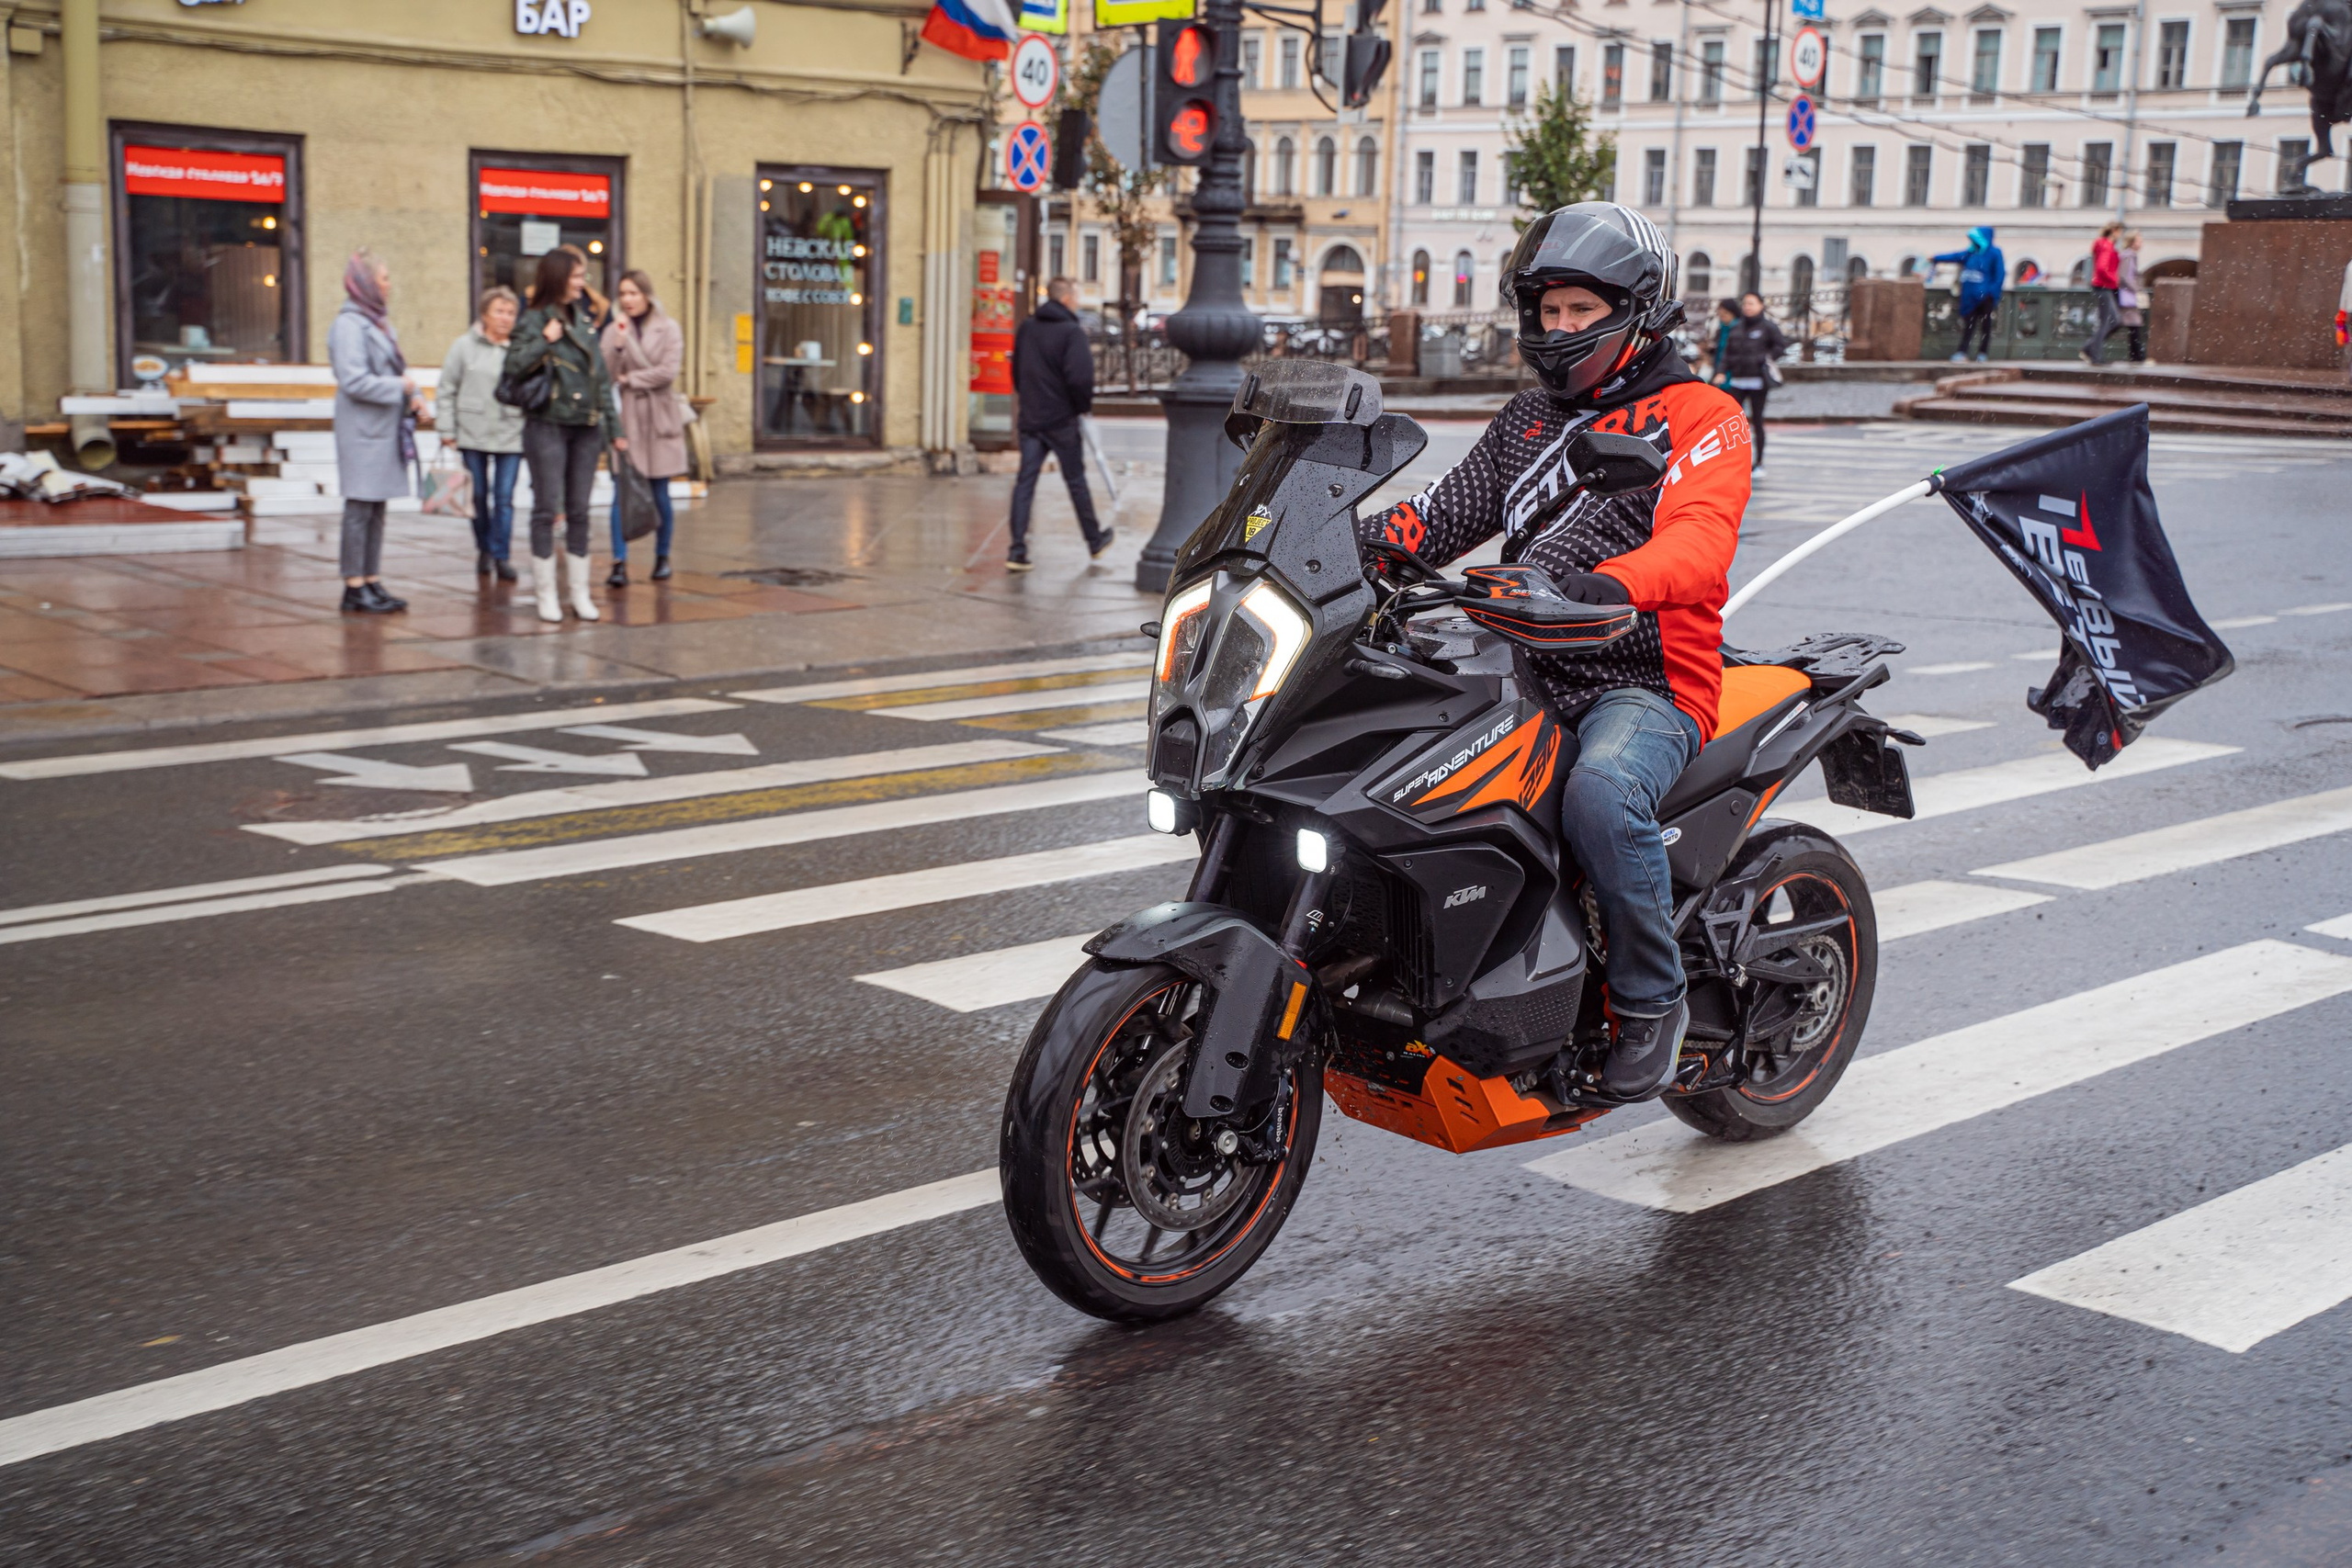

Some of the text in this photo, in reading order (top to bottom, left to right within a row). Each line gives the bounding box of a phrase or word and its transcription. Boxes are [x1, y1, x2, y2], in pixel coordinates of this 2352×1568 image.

[516, 0, 591, 38] БАР
[1799, 47, 1816, 69] 40
[1022, 58, 1048, 86] 40
[1247, 527, 1256, 536] 18
[1248, 517, 1271, 526] PROJECT
[1393, 714, 1514, 803] SUPER ADVENTURE
[1519, 724, 1557, 809] 1290
[1663, 833, 1679, 844] MOTO
[1443, 885, 1487, 909] KTM
[1275, 1106, 1285, 1143] brembo
